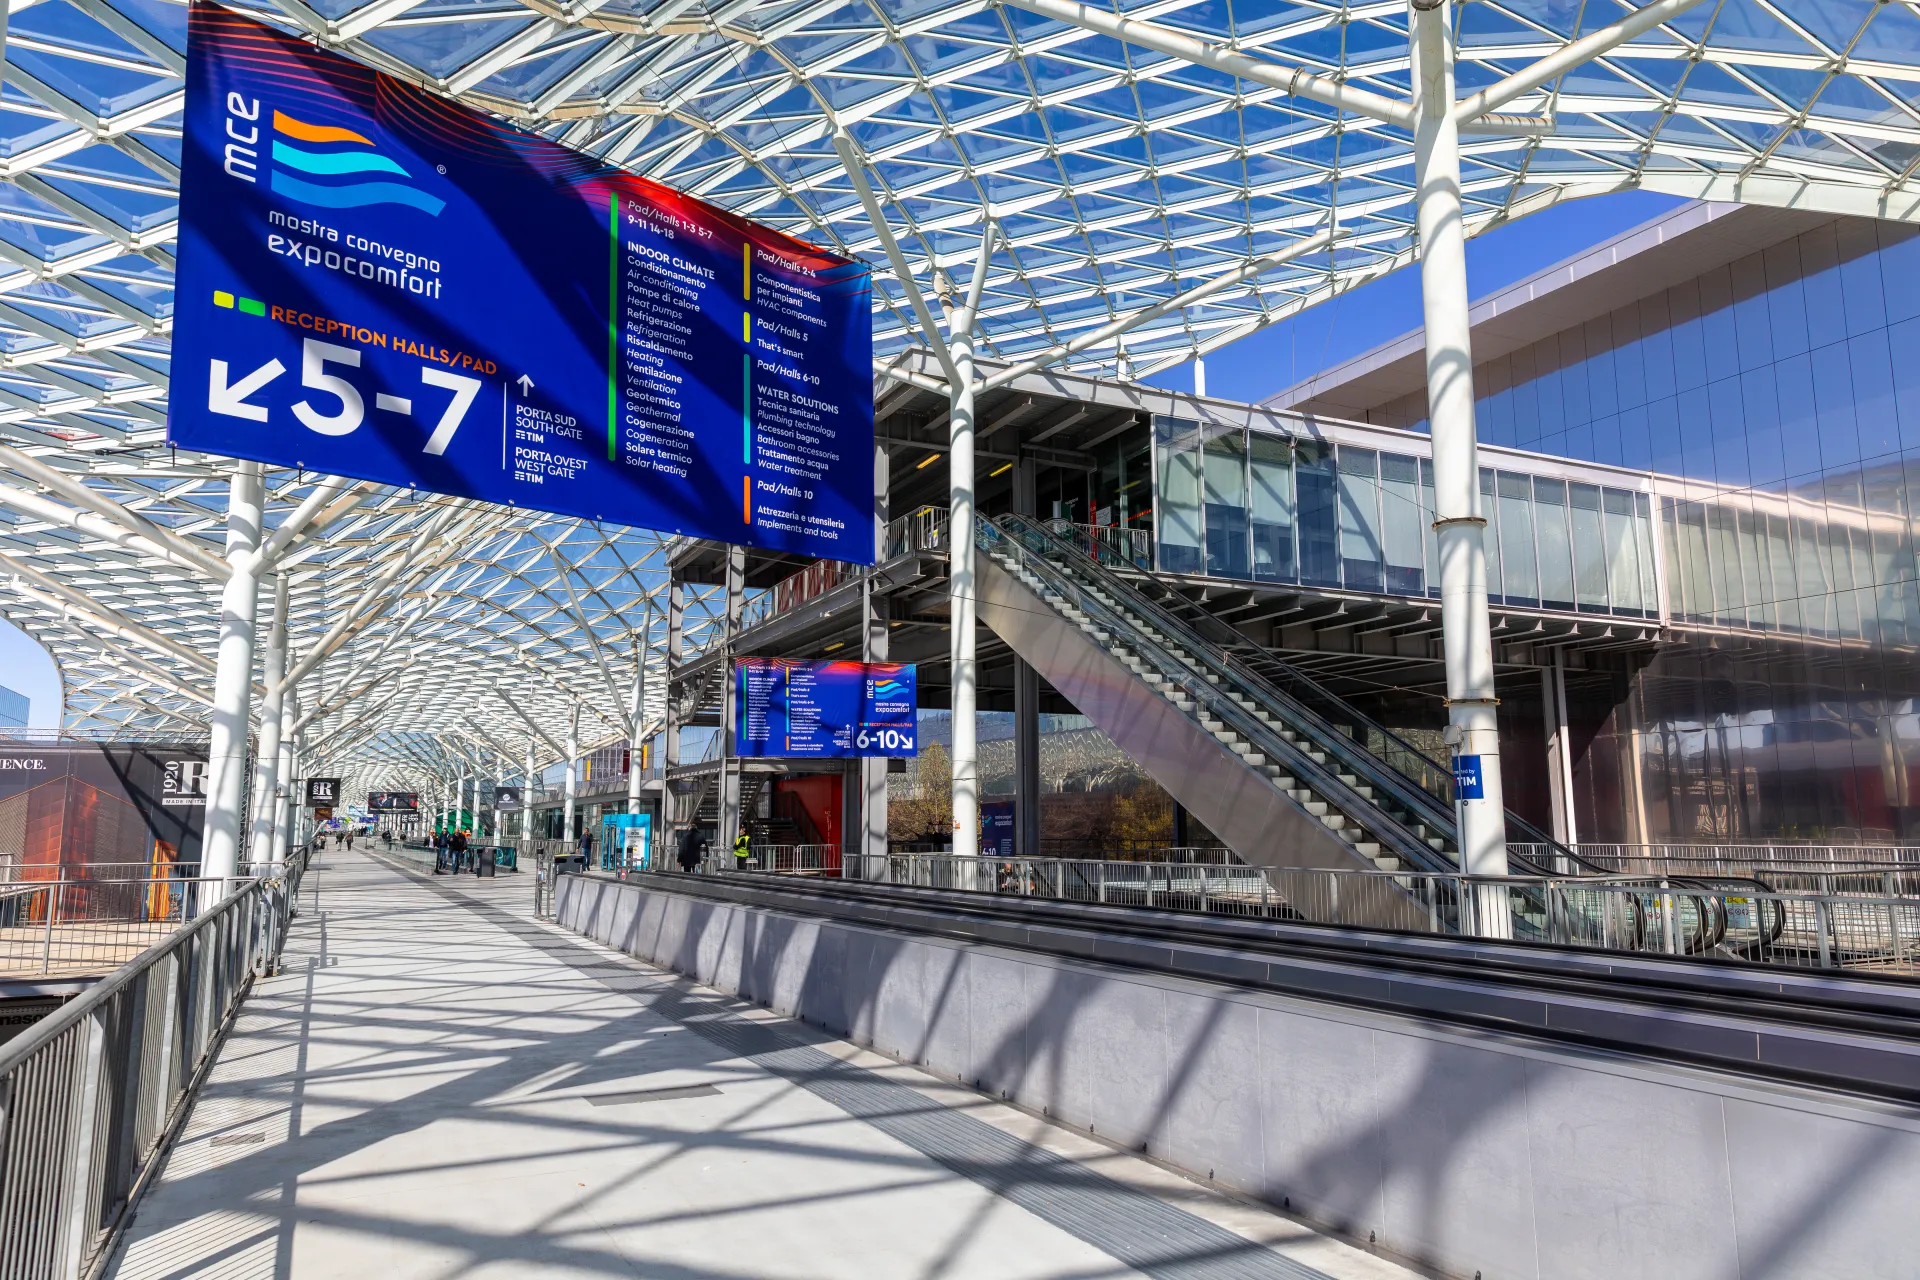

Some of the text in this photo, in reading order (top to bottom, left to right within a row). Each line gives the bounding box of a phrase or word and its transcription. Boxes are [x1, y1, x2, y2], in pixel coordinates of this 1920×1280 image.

[224, 91, 259, 183] mce
[628, 200, 713, 239] Pad/Halls 1-3 5-7
[628, 215, 674, 239] 9-11 14-18
[269, 211, 440, 272] mostra convegno
[268, 234, 442, 299] expocomfort
[628, 241, 715, 279] INDOOR CLIMATE
[628, 256, 706, 288] Condizionamento
[757, 250, 816, 278] Pad/Halls 2-4
[628, 269, 698, 300] Air conditioning
[757, 274, 820, 302] Componentistica
[628, 282, 700, 312] Pompe di calore
[628, 295, 682, 319] Heat pumps
[757, 287, 803, 307] per impianti
[628, 308, 692, 335] Refrigerazione
[757, 298, 827, 327] HVAC components
[271, 305, 497, 375] RECEPTION HALLS/PAD
[627, 321, 685, 346] Refrigeration
[757, 318, 808, 341] Pad/Halls 5
[627, 334, 693, 360] Riscaldamento
[627, 348, 663, 366] Heating
[757, 338, 804, 359] That's smart
[627, 361, 682, 383] Ventilazione
[757, 360, 820, 385] Pad/Halls 6-10
[290, 337, 482, 456] 5-7
[627, 375, 676, 395] Ventilation
[627, 388, 680, 409] Geotermico
[757, 397, 820, 421] Tecnica sanitaria
[758, 384, 839, 414] WATER SOLUTIONS
[516, 404, 576, 427] PORTA SUD
[627, 402, 681, 422] Geothermal
[758, 410, 835, 438] Plumbing technology
[516, 416, 582, 440] SOUTH GATE
[526, 432, 544, 443] TIM
[626, 415, 694, 438] Cogenerazione
[757, 422, 819, 444] Accessori bagno
[626, 429, 688, 450] Cogeneration
[757, 434, 839, 461] Bathroom accessories
[516, 447, 588, 470] PORTA OVEST
[626, 442, 692, 464] Solare termico
[757, 446, 828, 470] Trattamento acqua
[515, 458, 575, 479] WEST GATE
[526, 473, 543, 484] TIM
[626, 456, 687, 477] Solar heating
[758, 459, 822, 480] Water treatment
[758, 480, 813, 499] Pad/Halls 10
[758, 505, 799, 520] Attrezzeria
[808, 516, 844, 529] utensileria
[758, 518, 838, 539] Implements and tools
[857, 730, 899, 748] 6-10
[163, 760, 179, 795] 1920
[1457, 776, 1476, 786] TIM
